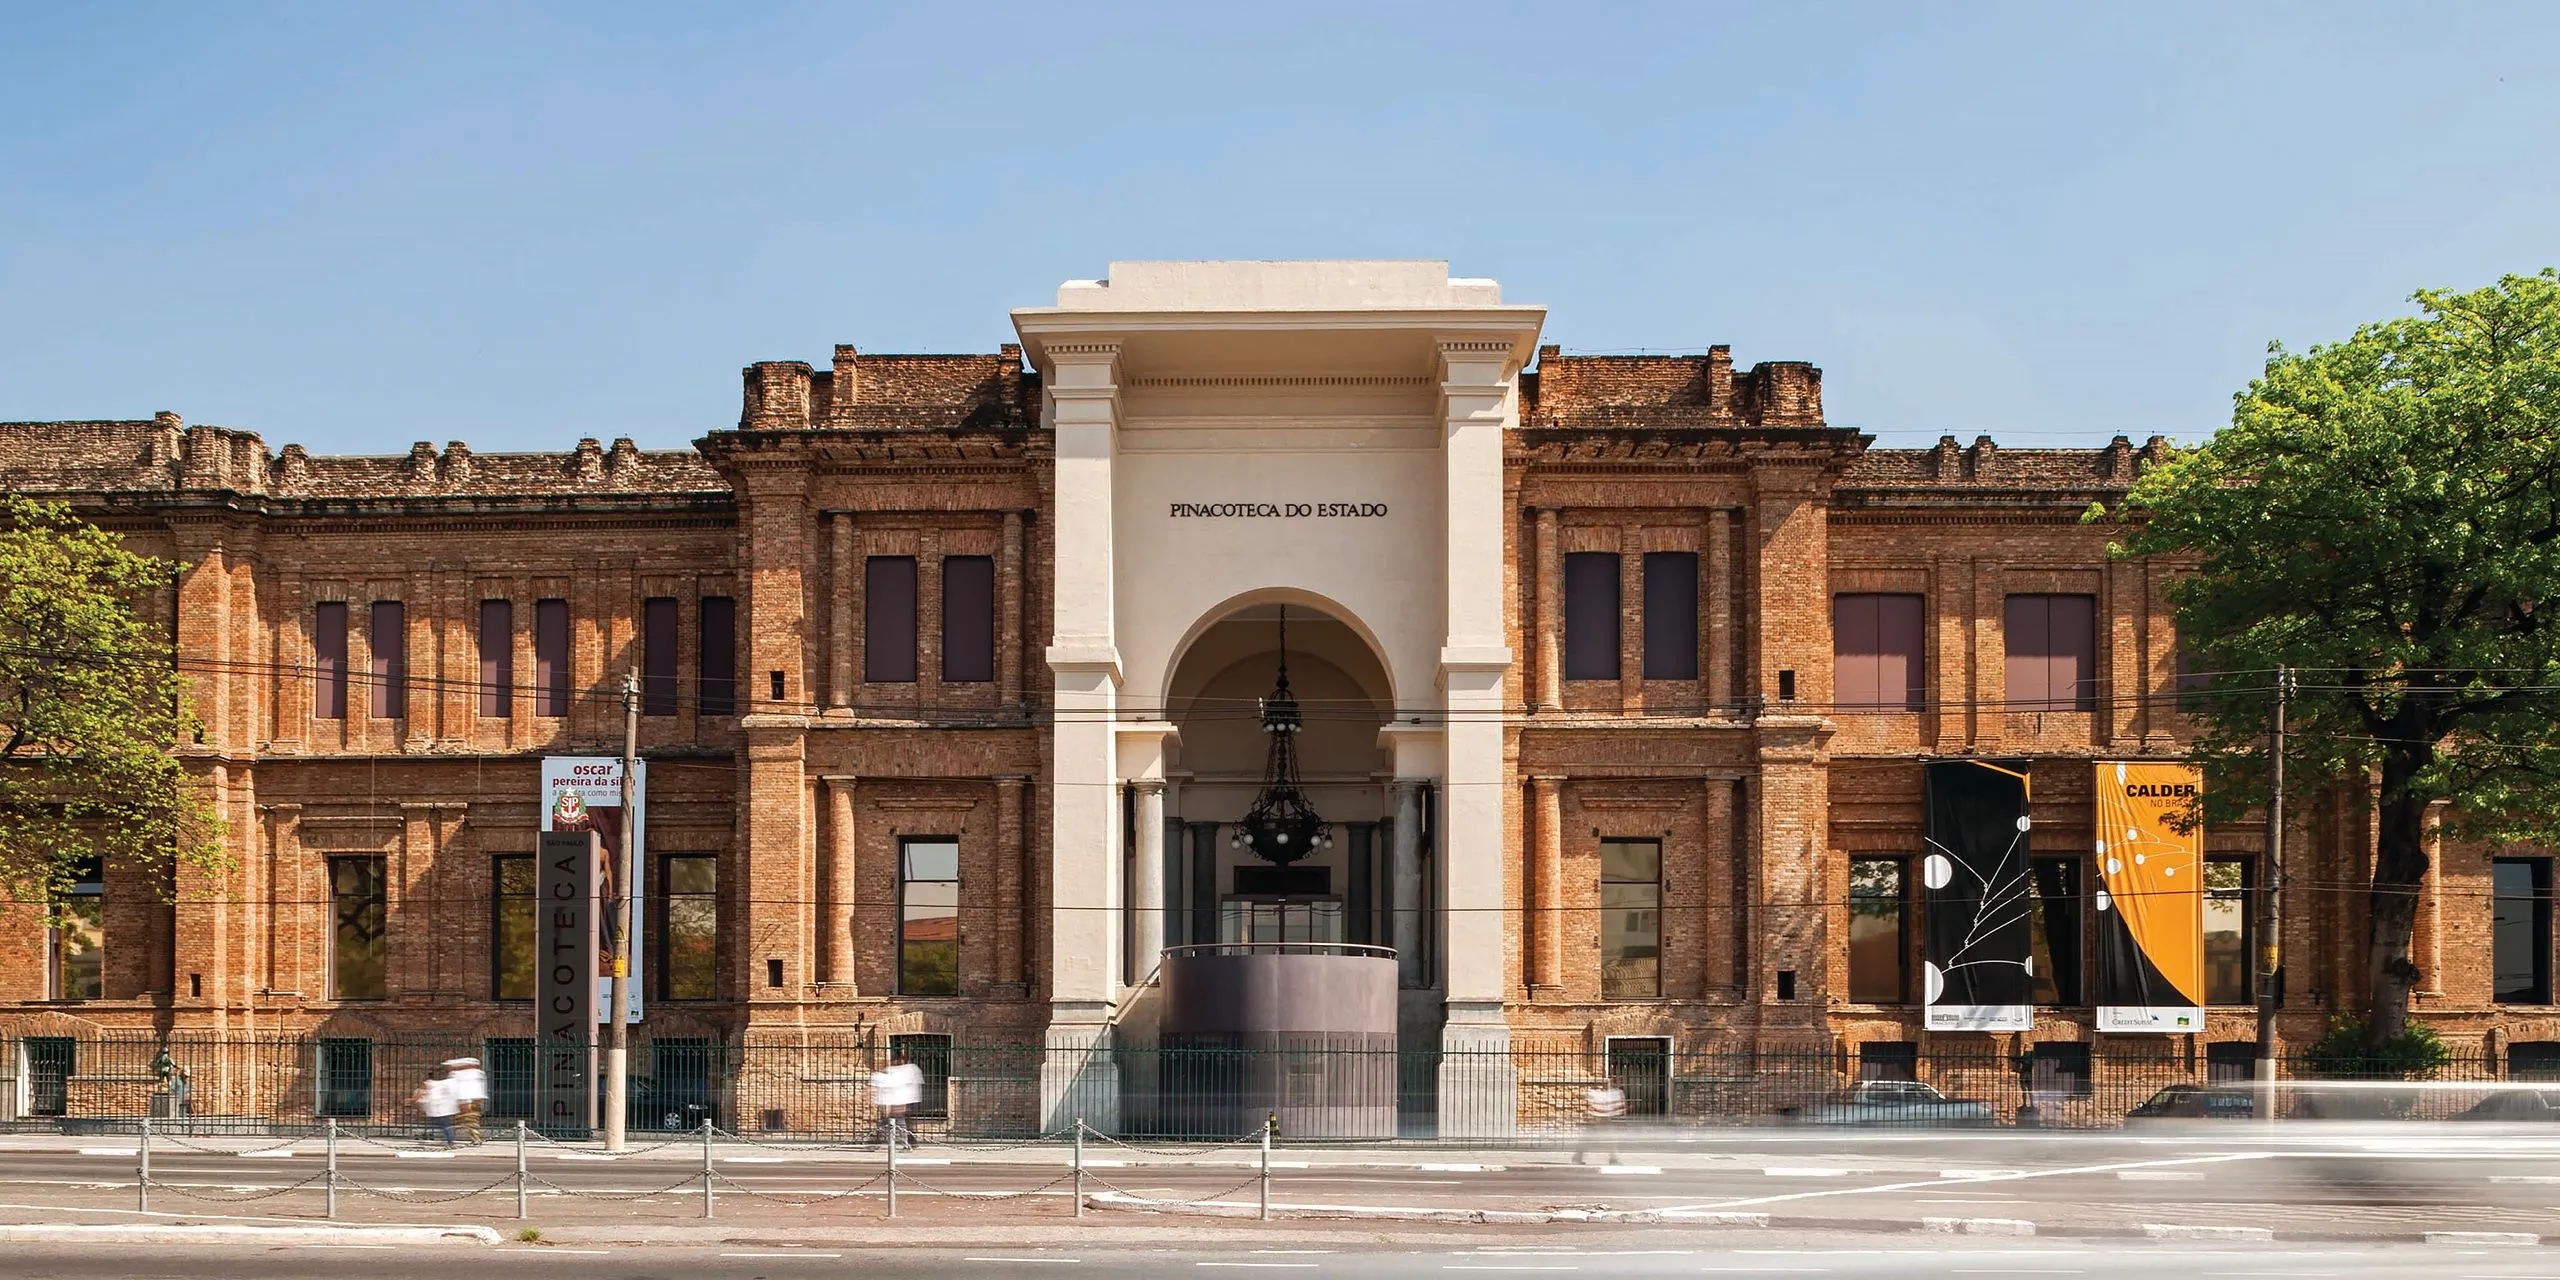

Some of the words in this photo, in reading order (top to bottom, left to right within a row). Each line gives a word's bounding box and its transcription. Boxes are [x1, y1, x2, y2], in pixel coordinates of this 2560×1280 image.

[1170, 503, 1281, 517] PINACOTECA
[1285, 503, 1312, 517] DO
[1317, 503, 1388, 517] ESTADO
[573, 765, 613, 775] oscar
[552, 776, 591, 788] pereira
[594, 776, 608, 786] da
[2126, 784, 2195, 797] CALDER
[2150, 799, 2163, 807] NO
[553, 855, 576, 1117] PINACOTECA
